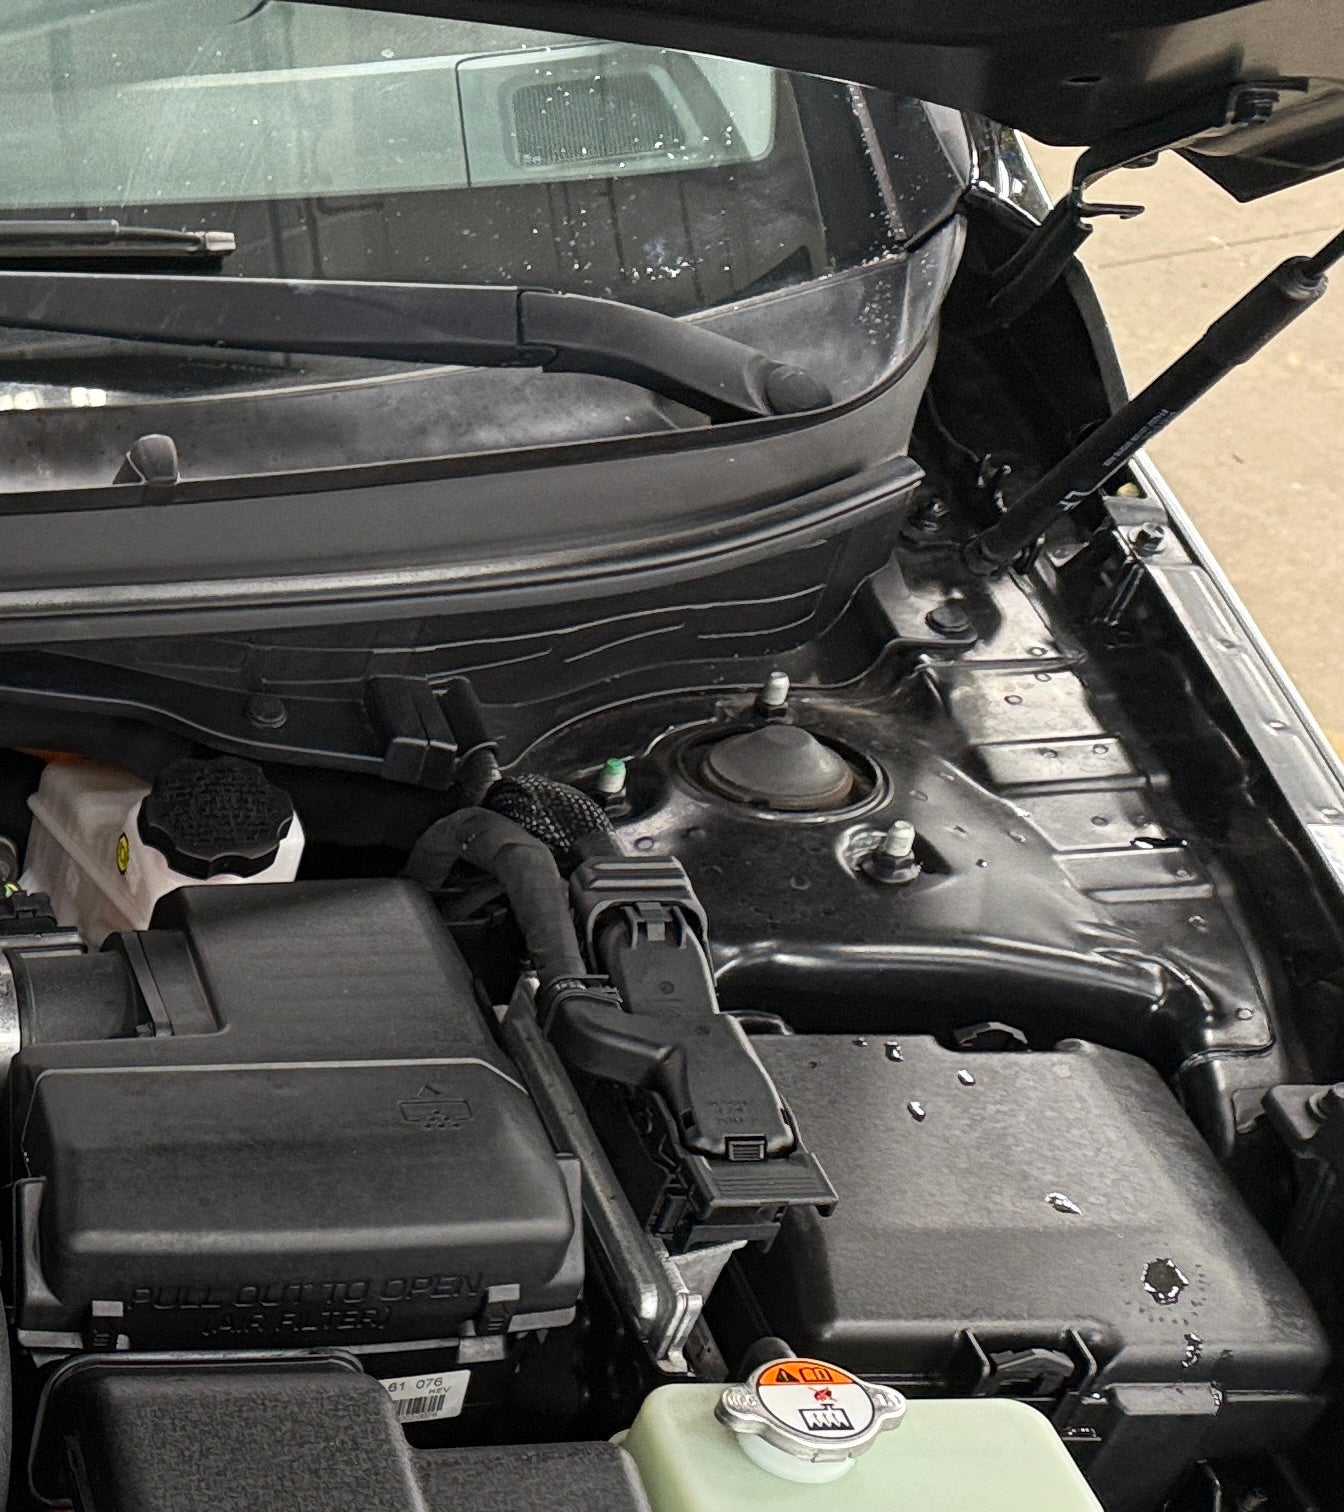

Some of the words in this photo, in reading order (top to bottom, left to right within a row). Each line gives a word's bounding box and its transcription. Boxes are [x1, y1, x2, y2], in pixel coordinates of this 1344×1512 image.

[128, 1285, 222, 1311] PULL
[233, 1281, 315, 1309] OUT
[321, 1280, 369, 1305] TO
[379, 1273, 484, 1302] OPEN
